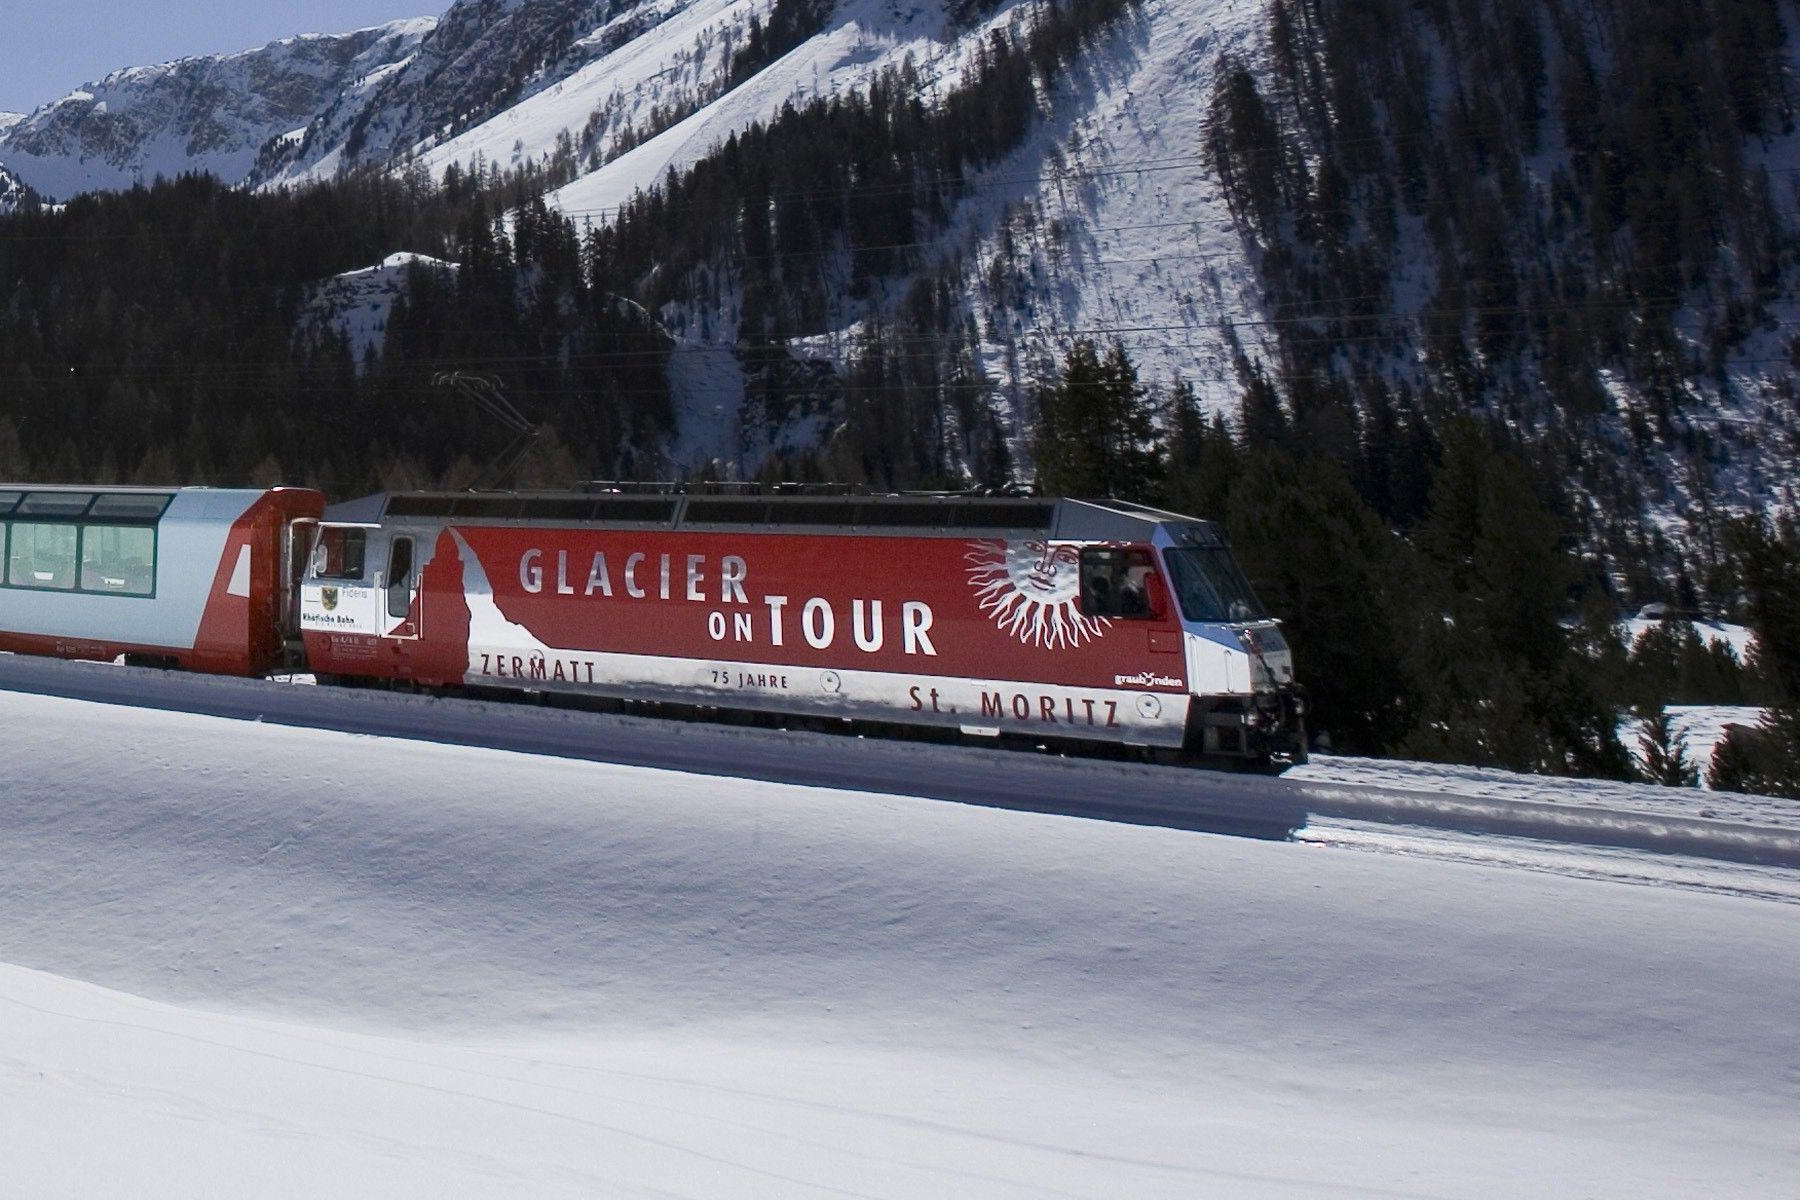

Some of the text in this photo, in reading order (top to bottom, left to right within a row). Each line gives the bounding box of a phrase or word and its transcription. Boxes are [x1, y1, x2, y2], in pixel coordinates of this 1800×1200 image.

[519, 548, 749, 603] GLACIER
[708, 595, 938, 656] ON TOUR
[481, 654, 595, 683] ZERMATT
[712, 671, 788, 689] 75 JAHRE
[909, 686, 1120, 728] St. MORITZ
